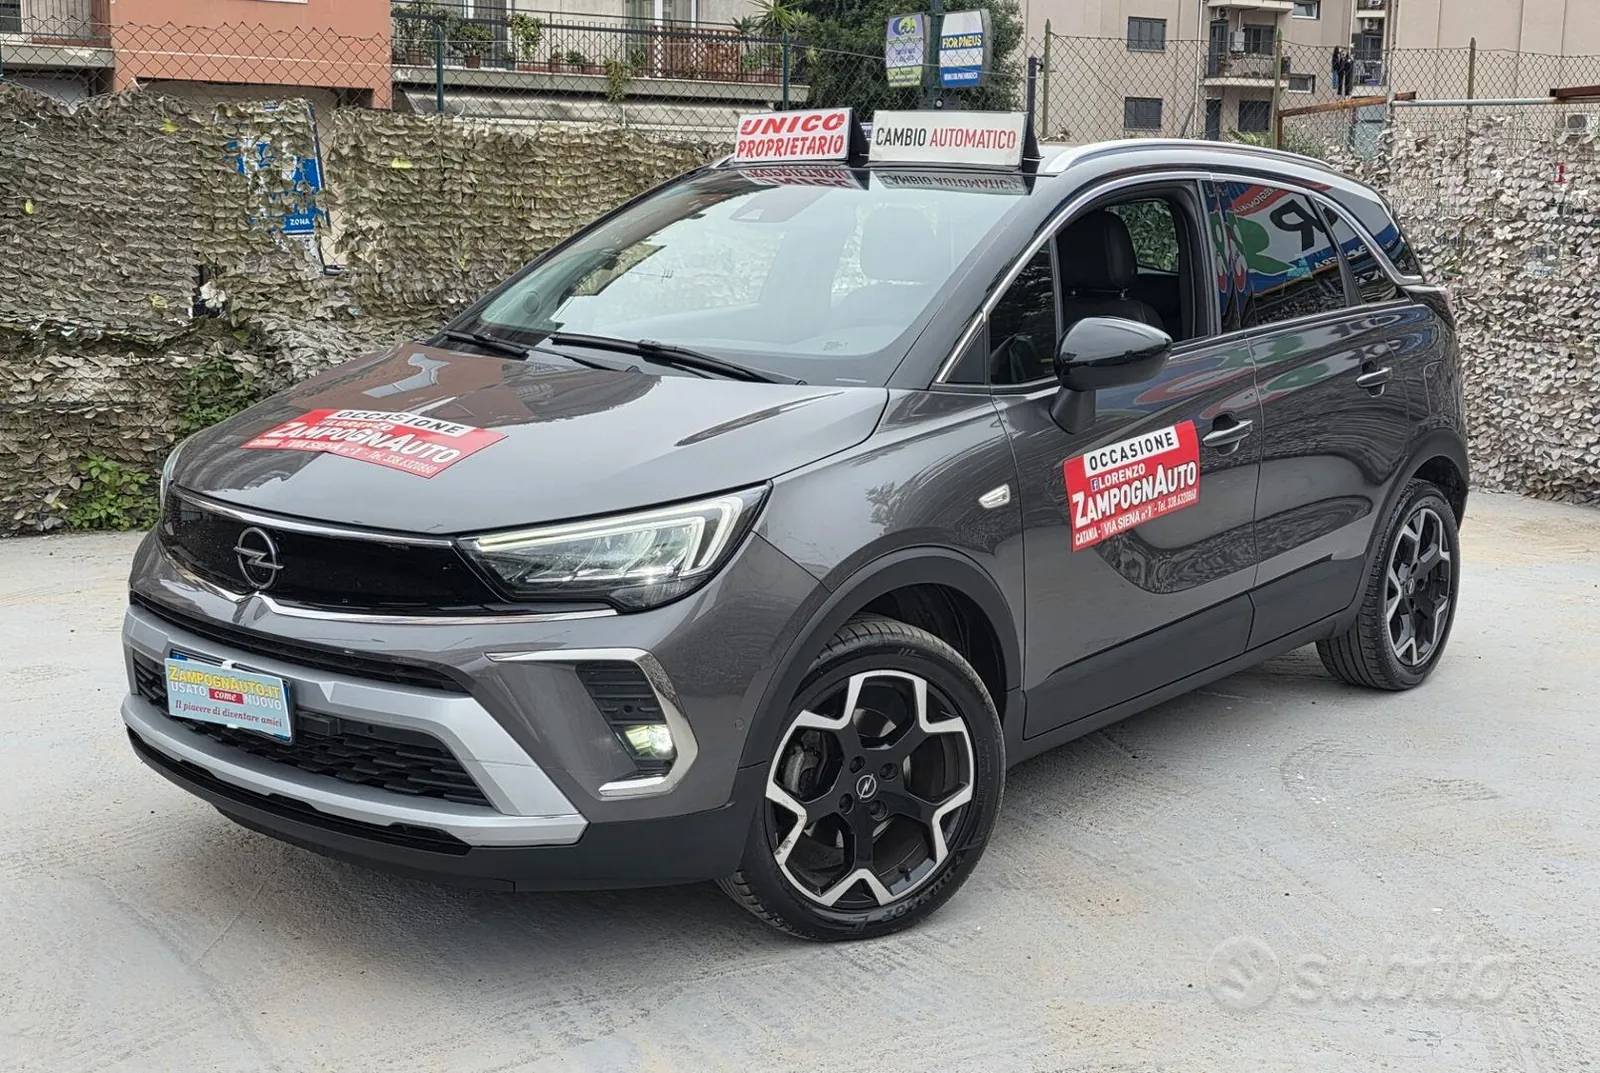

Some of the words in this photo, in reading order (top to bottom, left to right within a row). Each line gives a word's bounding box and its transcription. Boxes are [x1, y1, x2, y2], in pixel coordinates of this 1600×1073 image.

[740, 113, 845, 135] UNICO
[737, 135, 844, 158] PROPRIETARIO
[876, 128, 927, 147] CAMBIO
[930, 129, 1016, 149] AUTOMATICO
[290, 218, 310, 226] ZONA
[337, 411, 465, 434] OCCASIONE
[263, 421, 461, 464] ZAMPOGNAUTO
[1089, 432, 1174, 471] OCCASIONE
[1099, 463, 1146, 489] LORENZO
[1072, 461, 1197, 529] ZAMPOGNAUTO
[1076, 526, 1098, 546] CATANIA
[1103, 520, 1117, 534] VIA
[1118, 511, 1140, 531] SIENA
[168, 665, 279, 698] ZAMPOGNAUTO.IT
[171, 682, 206, 696] USATO
[214, 690, 237, 702] come
[244, 695, 282, 710] NUOVO
[176, 700, 182, 709] Il
[183, 702, 211, 714] piacere
[213, 707, 220, 716] di
[221, 708, 259, 722] diventare
[260, 717, 282, 728] amici
